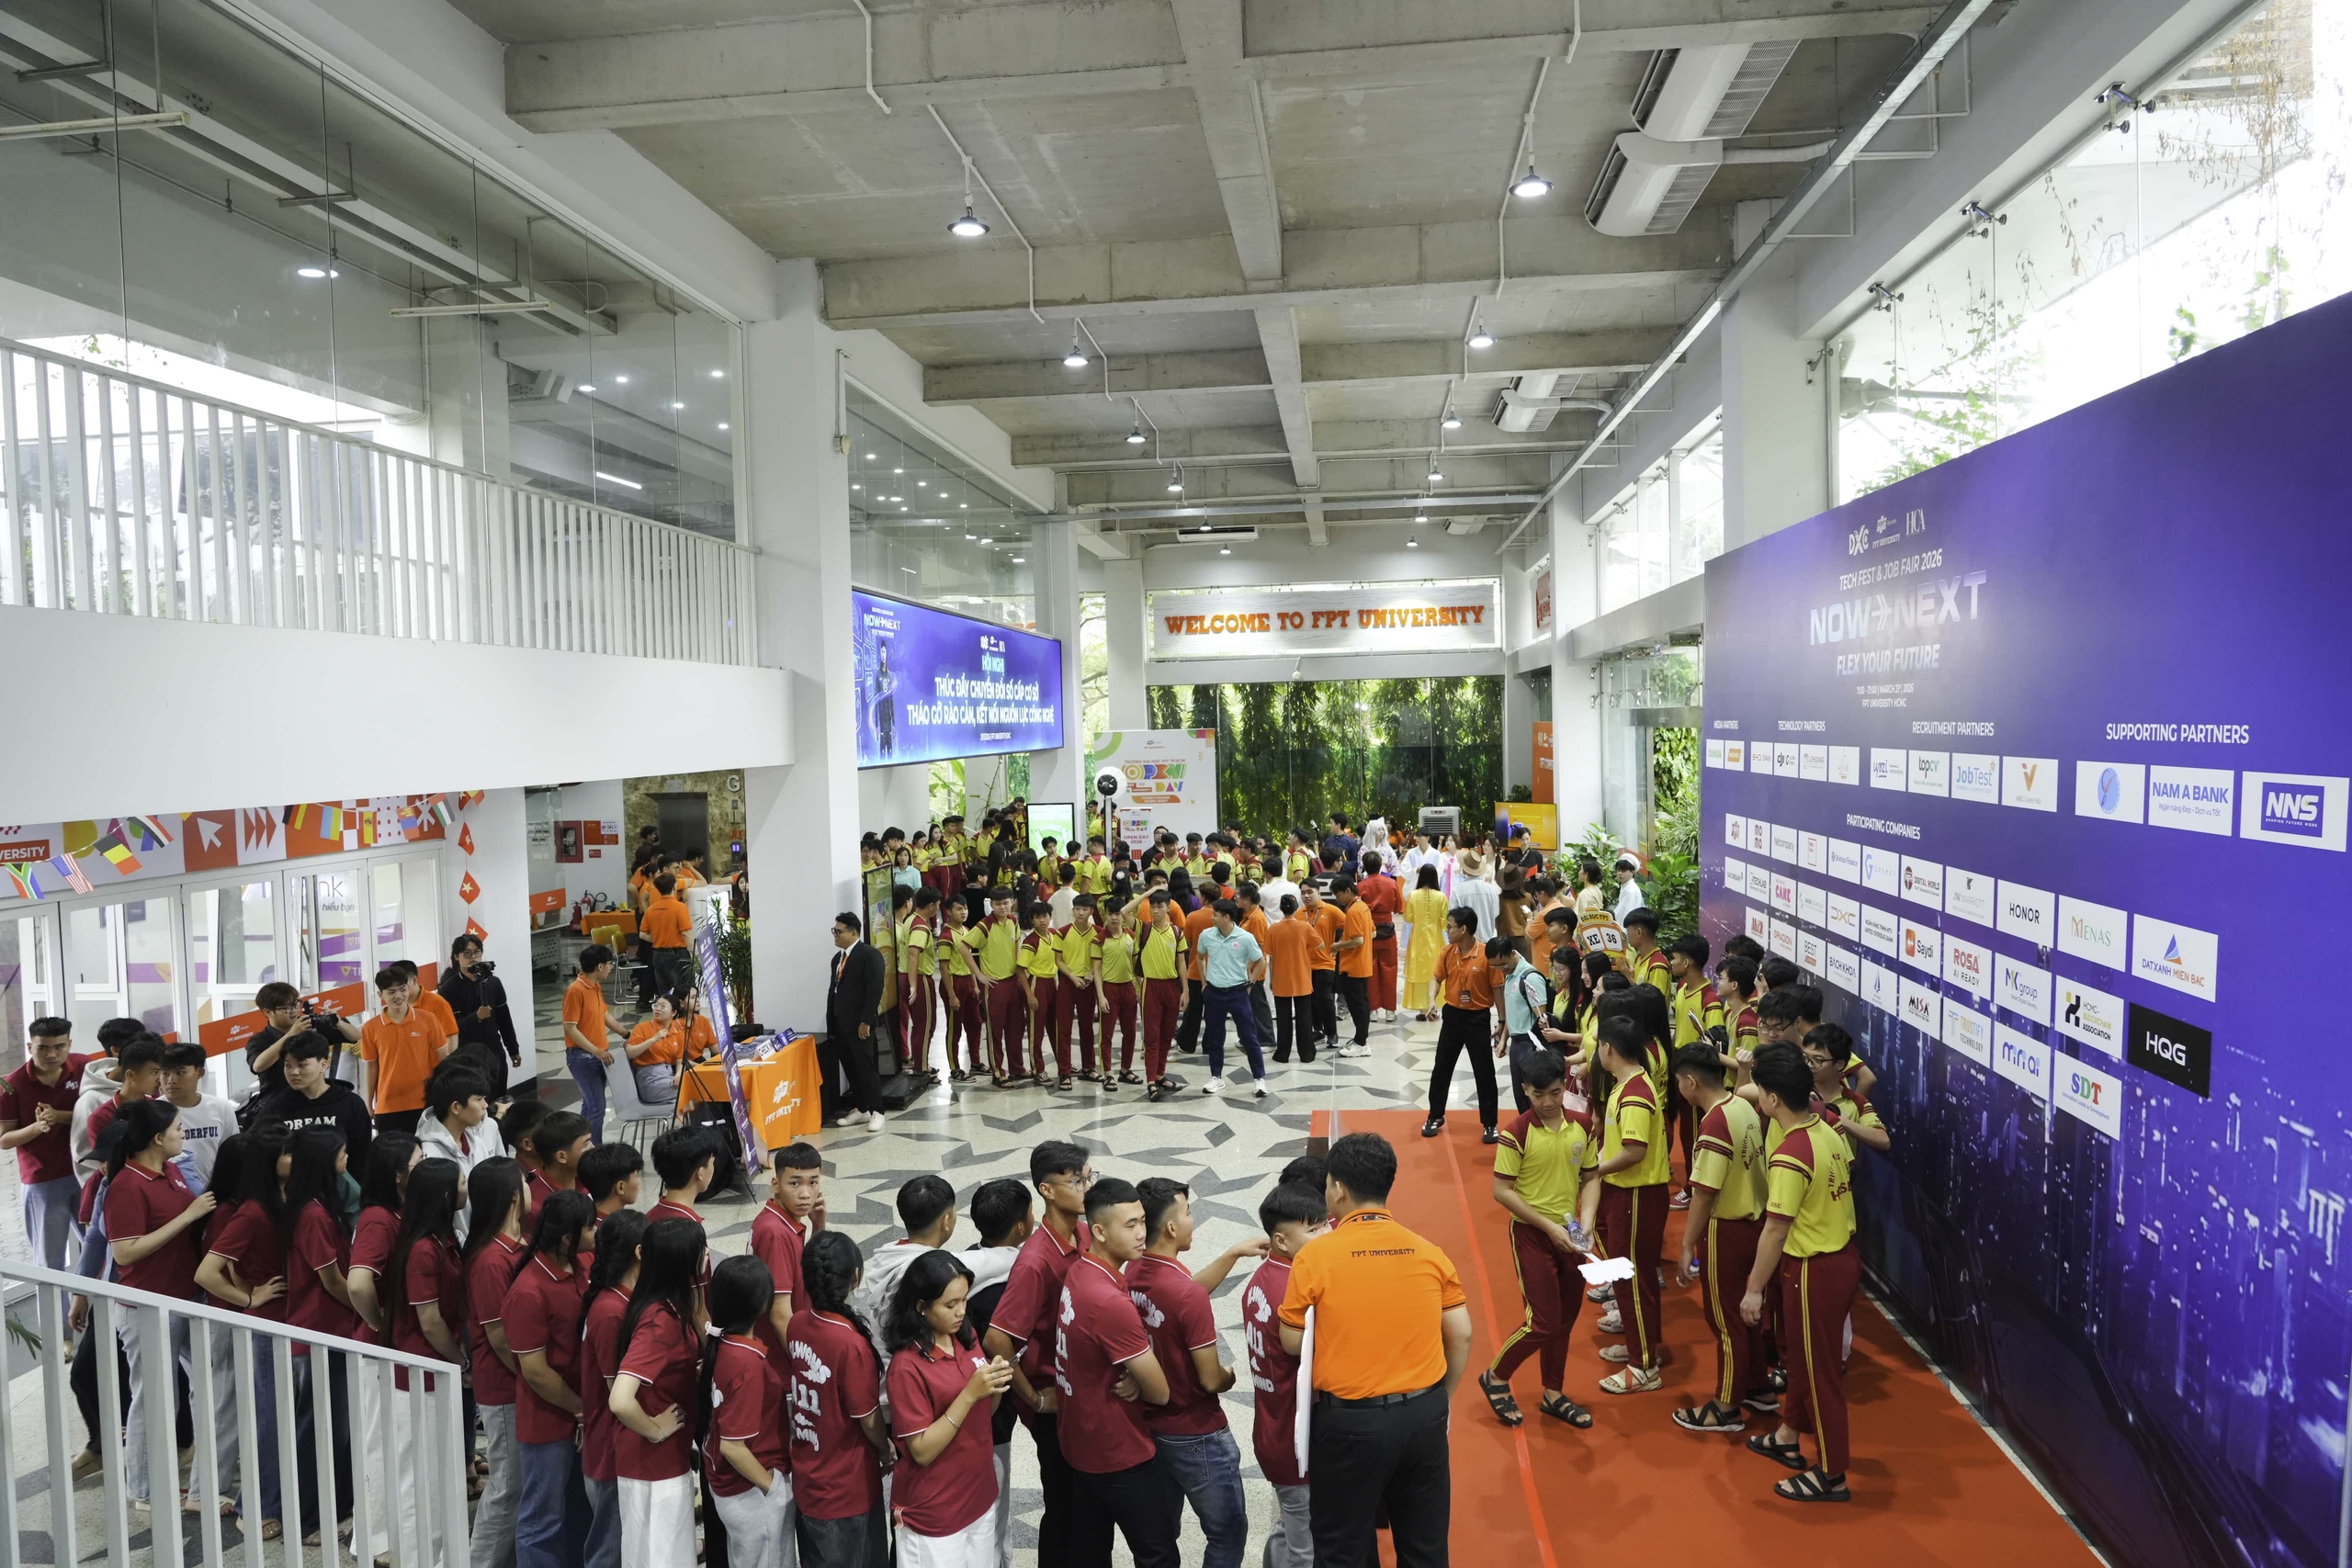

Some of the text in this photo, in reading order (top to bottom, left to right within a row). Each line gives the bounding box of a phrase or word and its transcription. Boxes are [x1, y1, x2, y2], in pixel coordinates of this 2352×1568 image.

[1839, 548, 1942, 591] TECH FEST & JOB FAIR 2026
[1810, 570, 1987, 646] NOW NEXT
[1164, 604, 1485, 635] WELCOME TO FPT UNIVERSITY
[1837, 643, 1940, 677] FLEX YOUR FUTURE
[934, 673, 956, 697] THÚC
[907, 700, 930, 726] THÁO
[944, 701, 959, 725] RÀO
[1778, 720, 1826, 731] TECHNOLOGY PARTNERS
[1912, 721, 1995, 736] RECRUITMENT PARTNERS
[2106, 723, 2250, 744] SUPPORTING PARTNERS
[727, 774, 741, 792] G
[1956, 766, 1993, 786] JobTest
[1156, 782, 1183, 792] DAY
[2153, 782, 2229, 804] NAM A BANK
[2265, 791, 2320, 822] NNS
[1847, 813, 1921, 840] PARTICIPATING COMPANIES
[1775, 885, 1792, 903] CAKE
[2009, 902, 2040, 925] HONOR
[1587, 932, 1617, 946] XE 36
[2071, 915, 2111, 947] MENAS
[1804, 941, 1817, 956] BEST
[1917, 940, 1934, 959] Saydi
[1953, 948, 1979, 973] ROSA
[1961, 971, 1980, 987] READY
[2142, 958, 2205, 987] DATXANH MIEN BAC
[2019, 983, 2038, 1000] group
[1908, 995, 1929, 1016] MISA
[1961, 1015, 1984, 1040] TRUSTIFY
[2083, 1012, 2111, 1030] BLOCKCHAIN
[2083, 1023, 2111, 1041] ASSOCIATION
[1960, 1032, 1984, 1054] TECHNOLOGY
[2146, 1031, 2187, 1067] HQG
[2071, 1072, 2102, 1106] SDT
[764, 1098, 802, 1125] FPT UNIVTY
[183, 1126, 219, 1140] DERFUL
[283, 1115, 337, 1131] DREAM
[1369, 1248, 1416, 1257] UNIVERSITY
